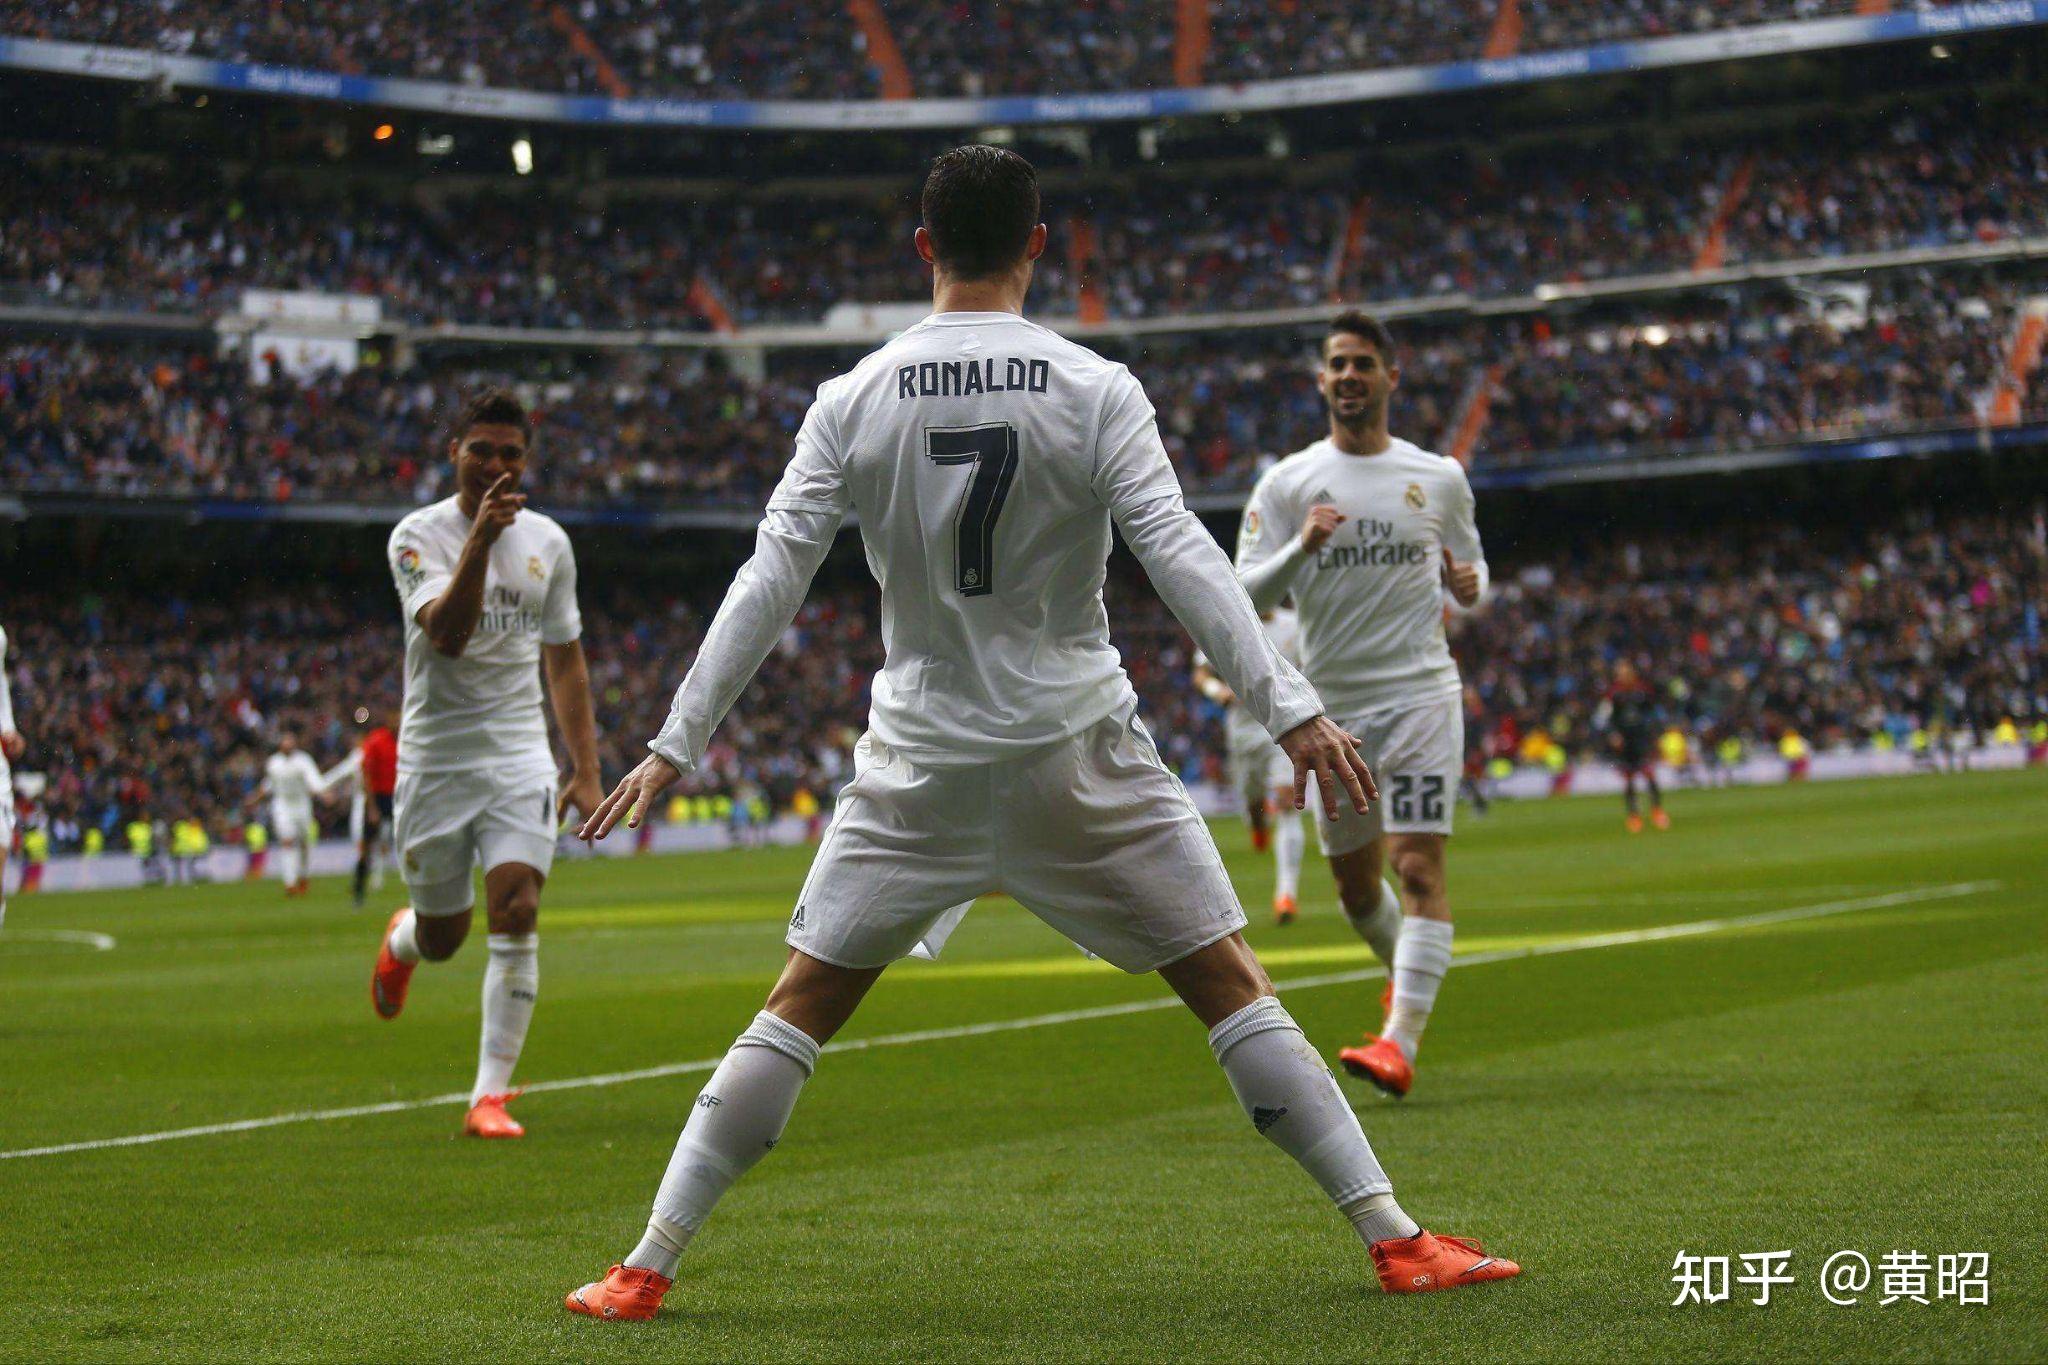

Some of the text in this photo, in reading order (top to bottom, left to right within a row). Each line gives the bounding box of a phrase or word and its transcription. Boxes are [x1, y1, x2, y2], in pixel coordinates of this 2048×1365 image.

[899, 358, 1049, 399] RONALDO
[924, 421, 1019, 597] 7
[1357, 517, 1393, 540] Fly
[1392, 775, 1444, 821] 22
